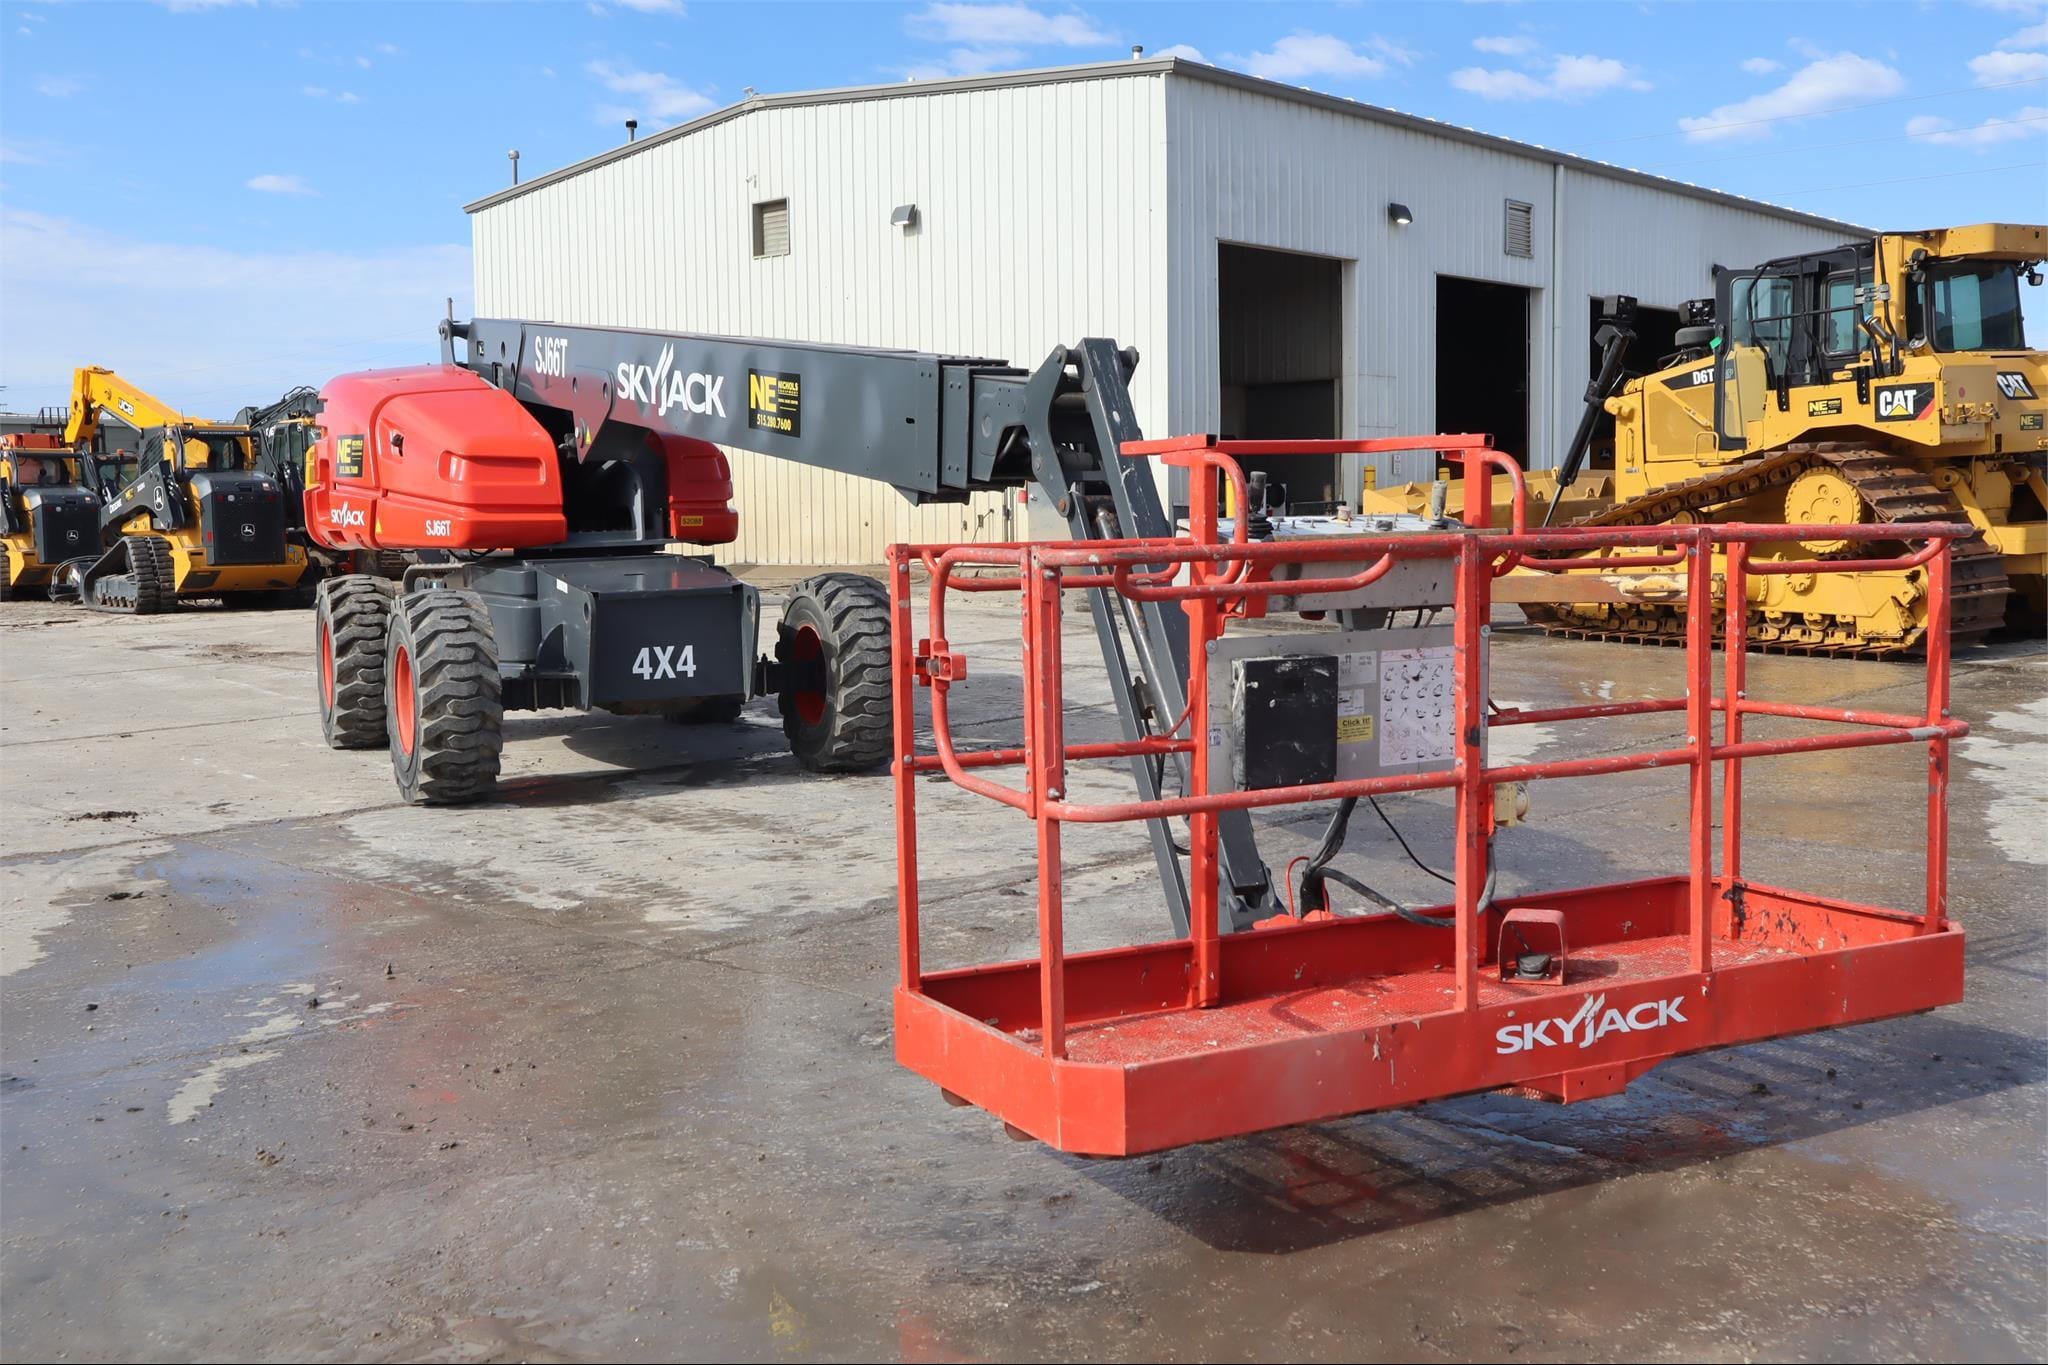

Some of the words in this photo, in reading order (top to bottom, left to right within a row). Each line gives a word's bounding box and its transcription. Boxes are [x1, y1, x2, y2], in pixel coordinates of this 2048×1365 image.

[535, 335, 568, 379] SJ66T
[617, 342, 727, 418] SKYJACK
[1692, 368, 1715, 385] D6T
[1997, 374, 2033, 398] CAT
[750, 374, 777, 413] NE
[1809, 400, 1828, 413] NE
[1879, 389, 1917, 417] CAT
[118, 399, 134, 416] JCB
[337, 438, 352, 464] NE
[330, 501, 365, 528] SKYJACK
[425, 519, 452, 537] SJ66T
[632, 644, 697, 681] 4X4
[1495, 992, 1689, 1055] SKYJACK
